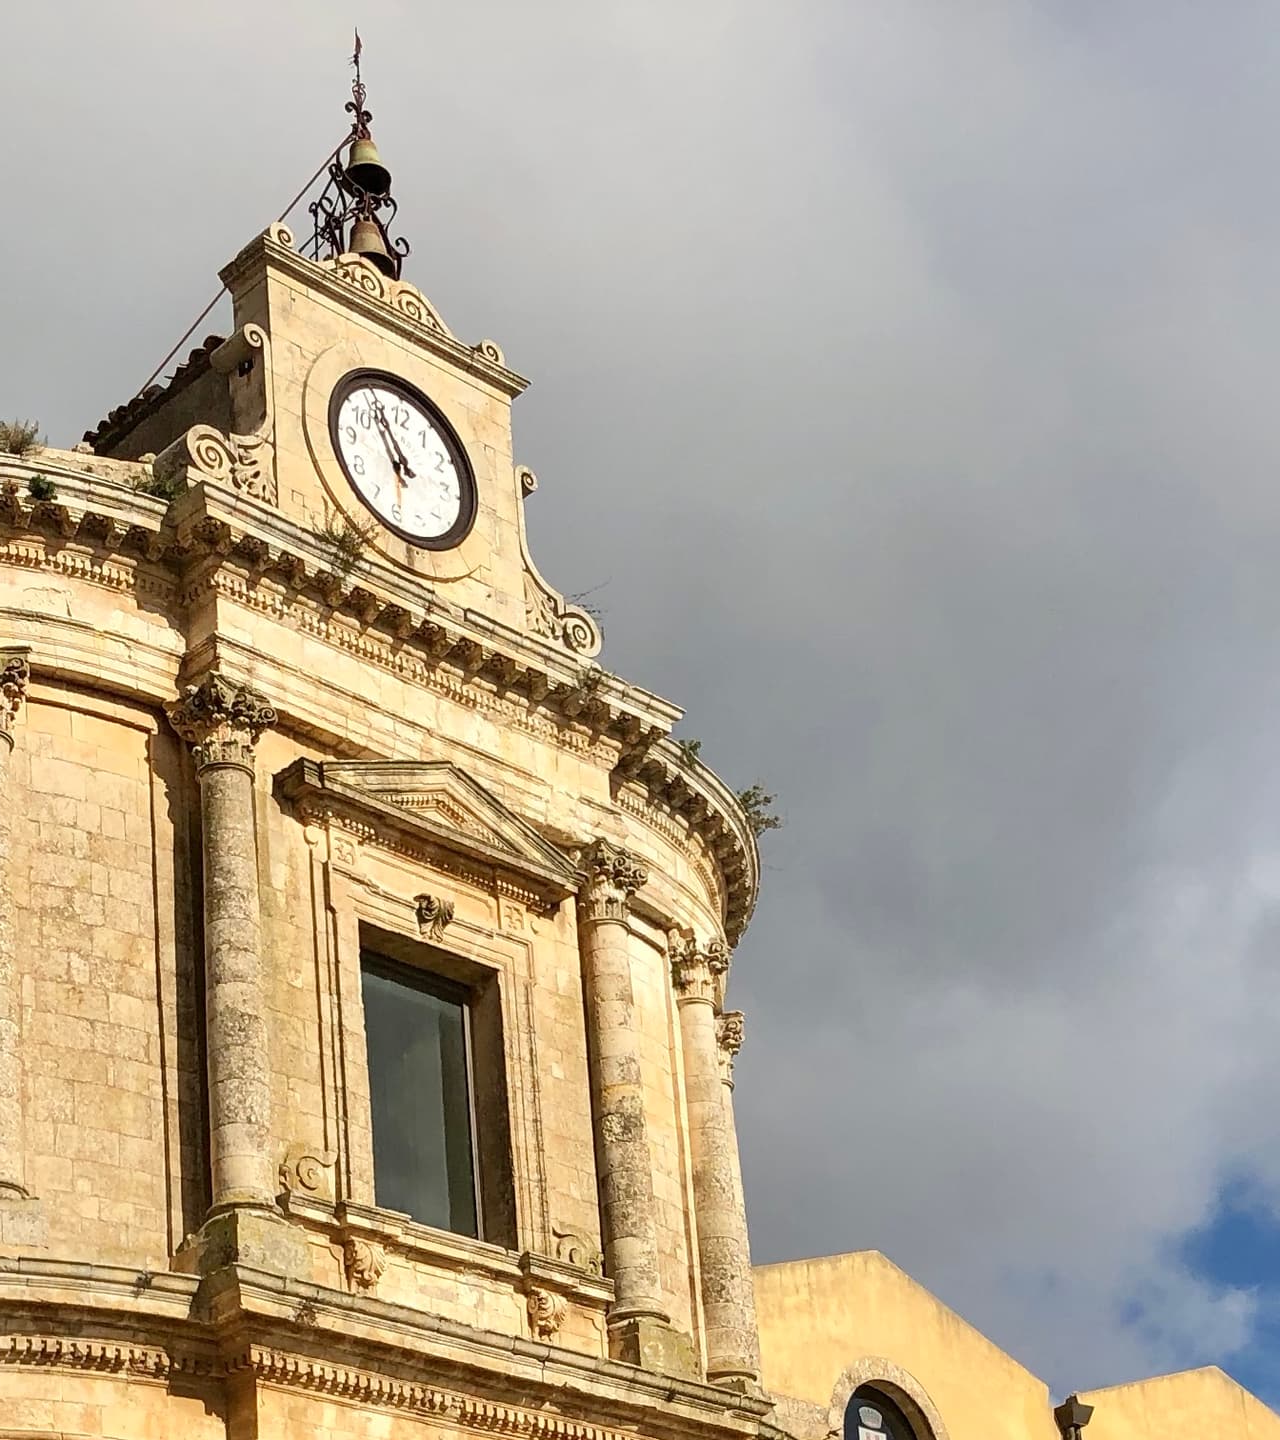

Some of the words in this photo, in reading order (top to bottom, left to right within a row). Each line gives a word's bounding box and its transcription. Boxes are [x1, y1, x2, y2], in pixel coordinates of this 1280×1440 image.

[391, 405, 410, 431] 12
[346, 426, 357, 445] 9
[418, 430, 427, 448] 1
[434, 451, 445, 473] 2
